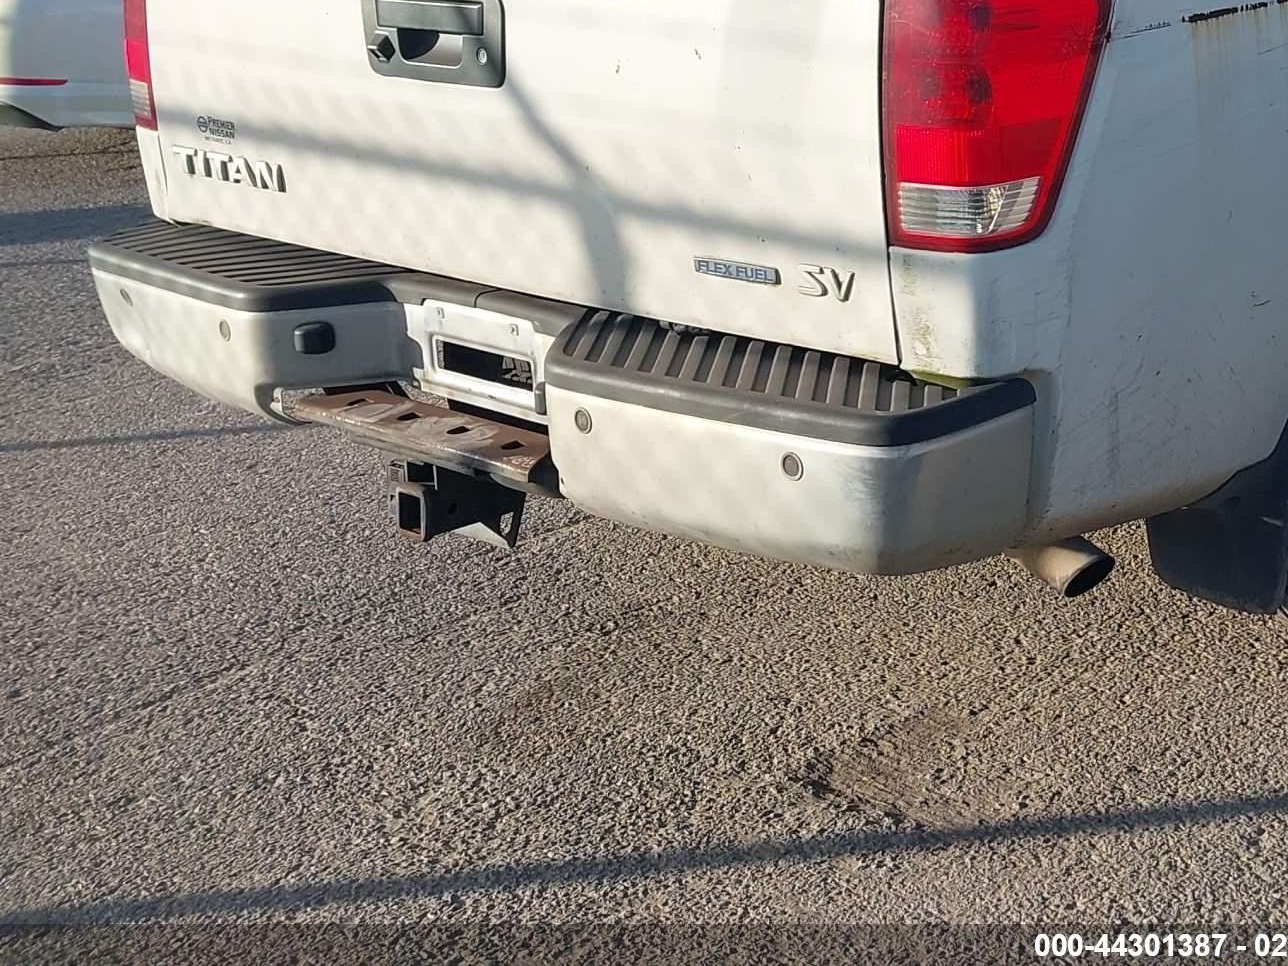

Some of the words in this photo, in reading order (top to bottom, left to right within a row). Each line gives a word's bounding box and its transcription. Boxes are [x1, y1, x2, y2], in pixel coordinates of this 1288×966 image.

[209, 127, 236, 140] NISSAN
[172, 144, 287, 193] TITAN
[697, 259, 733, 276] FLEX
[735, 265, 775, 283] FUEL
[798, 262, 856, 303] SV
